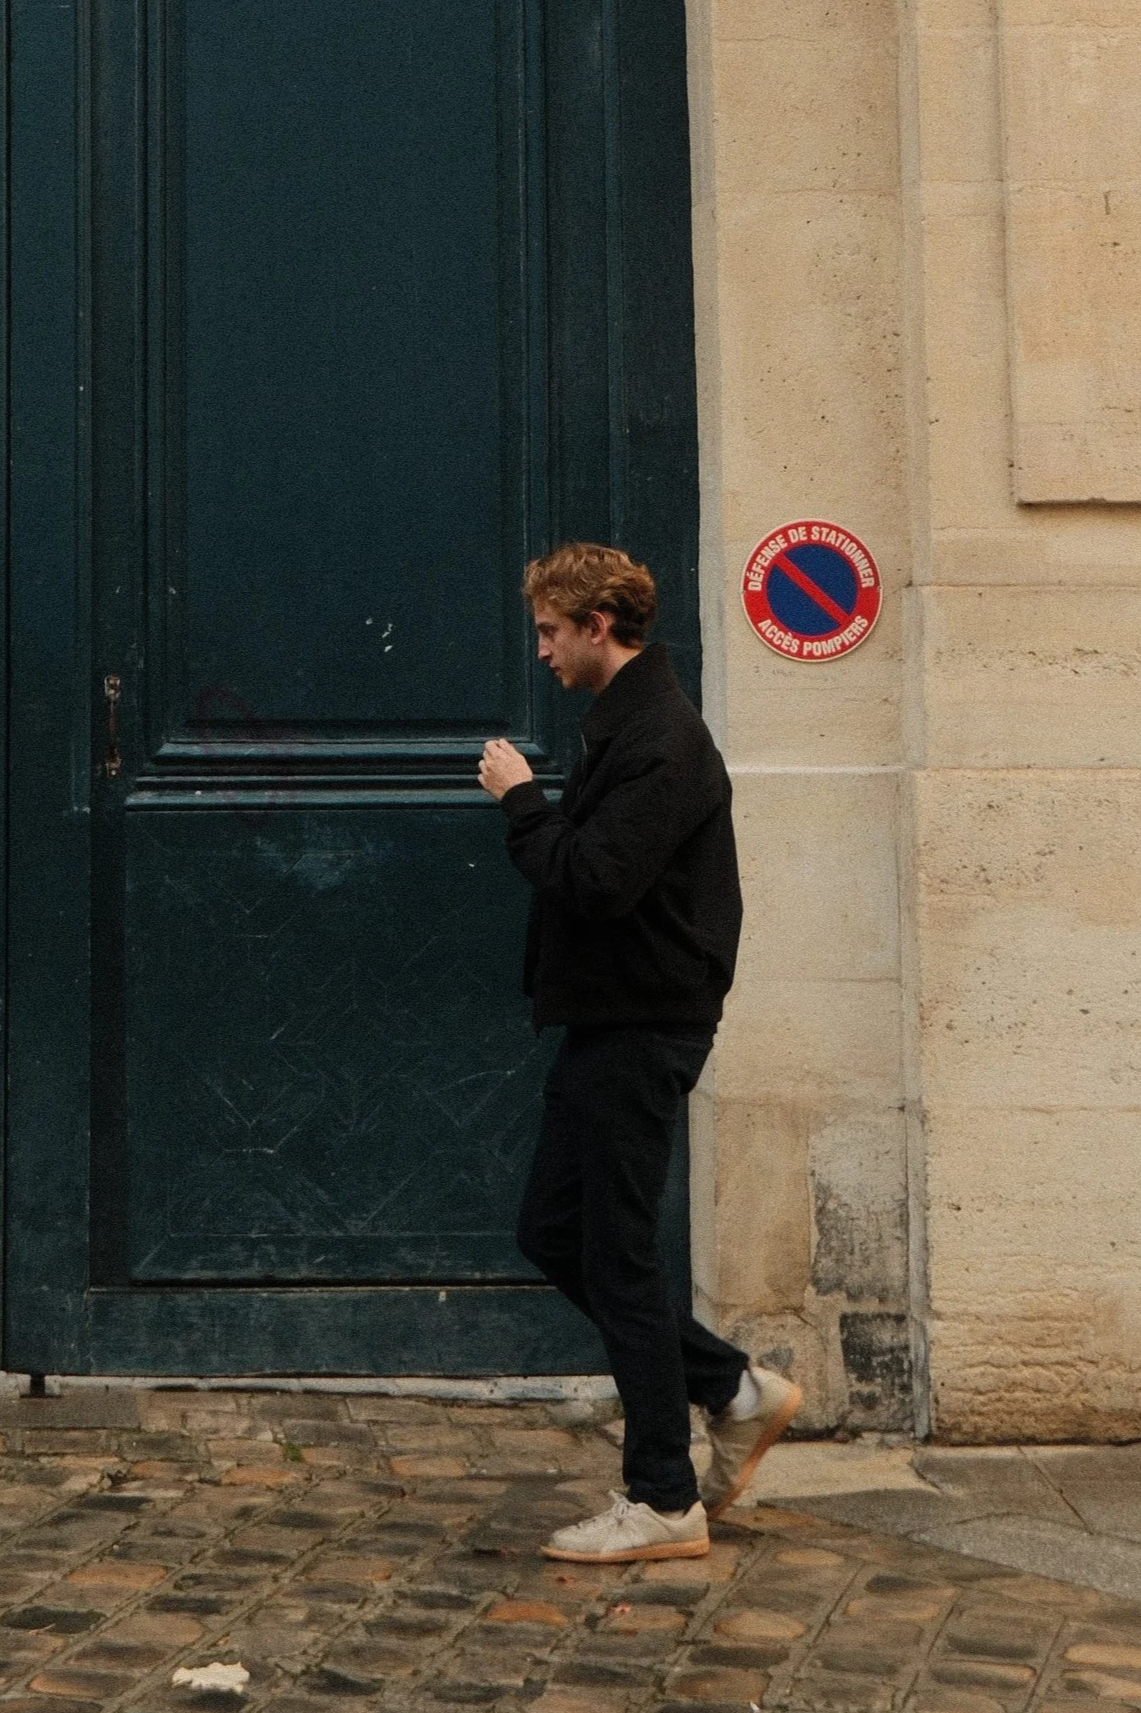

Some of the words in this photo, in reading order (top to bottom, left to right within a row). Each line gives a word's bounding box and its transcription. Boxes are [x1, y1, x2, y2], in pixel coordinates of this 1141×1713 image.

[746, 534, 788, 592] DÉFENSE
[787, 526, 808, 543] DE
[810, 525, 875, 589] STATIONNER
[757, 618, 800, 654] ACCÈS
[802, 615, 869, 657] POMPIERS
